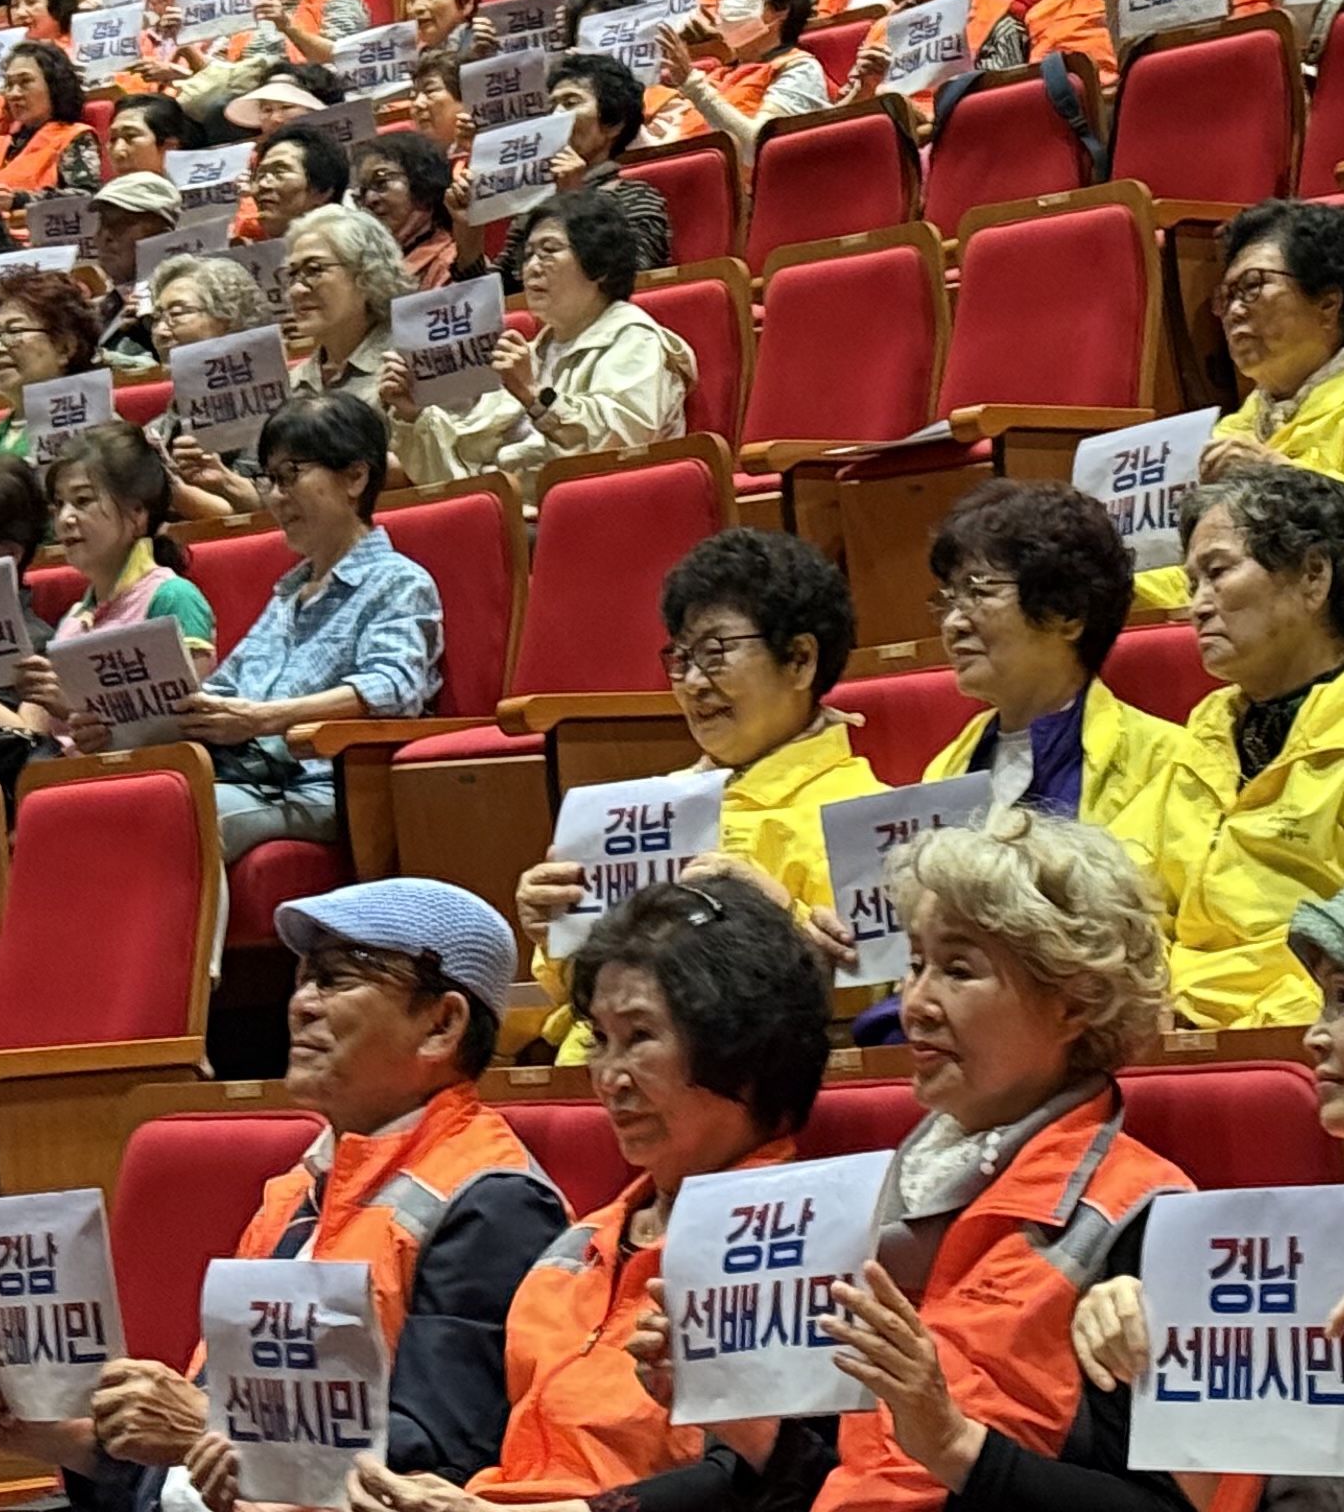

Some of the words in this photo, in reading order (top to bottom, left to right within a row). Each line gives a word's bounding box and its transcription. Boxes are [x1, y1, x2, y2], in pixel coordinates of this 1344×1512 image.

[908, 12, 942, 46] 경남
[890, 36, 964, 81] 선배시민
[472, 92, 544, 126] 선배시민
[499, 134, 542, 165] 경남
[426, 303, 472, 341] 경남
[204, 351, 253, 389] 경남
[50, 392, 88, 426] 경남
[189, 380, 288, 429] 선배시민
[1111, 441, 1170, 492] 경남
[89, 647, 150, 686] 경남
[84, 677, 192, 727] 선배시민
[604, 806, 675, 855] 경남
[722, 1198, 815, 1274] 경남
[1208, 1236, 1304, 1314] 경남
[250, 1301, 319, 1369] 경남
[680, 1274, 854, 1361] 선배시민
[226, 1376, 372, 1448] 선배시민
